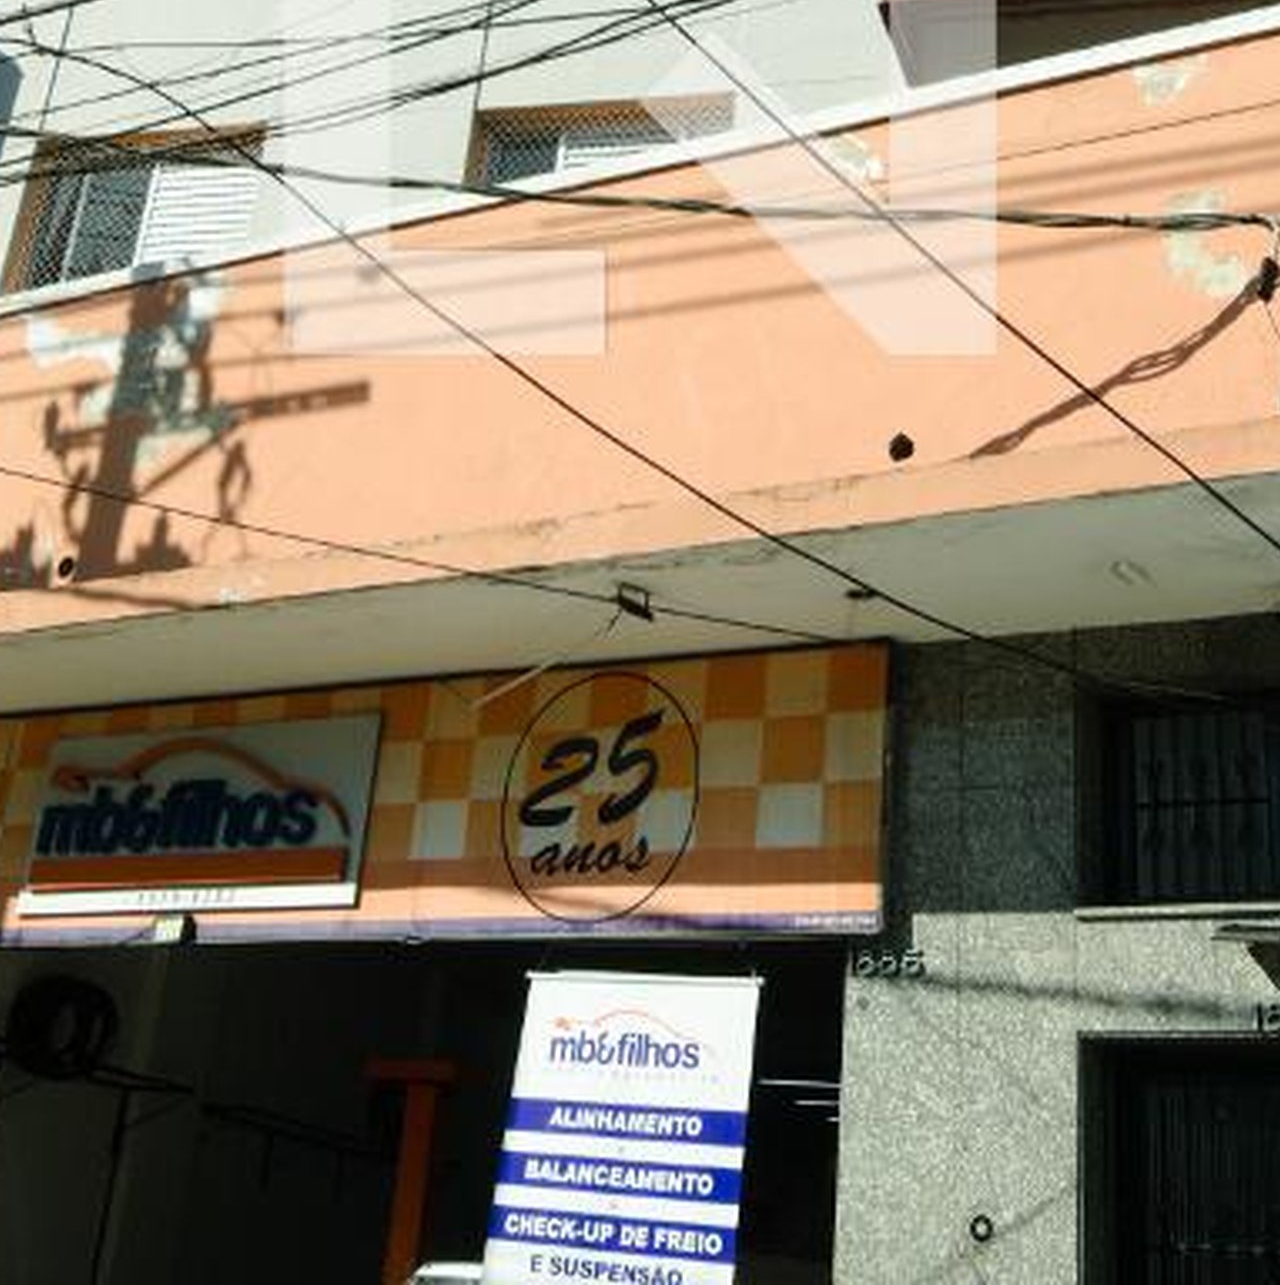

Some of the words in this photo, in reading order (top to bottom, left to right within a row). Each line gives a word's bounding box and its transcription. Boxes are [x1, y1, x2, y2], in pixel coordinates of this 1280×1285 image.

[520, 708, 666, 827] 25
[530, 835, 649, 876] anos
[549, 1105, 704, 1138] ALINHAMENTO
[523, 1158, 714, 1196] BALANCEAMENTO
[503, 1213, 614, 1244] CHECK-UP
[619, 1224, 649, 1248] DE
[653, 1230, 723, 1255] FREIO
[530, 1254, 545, 1273] E
